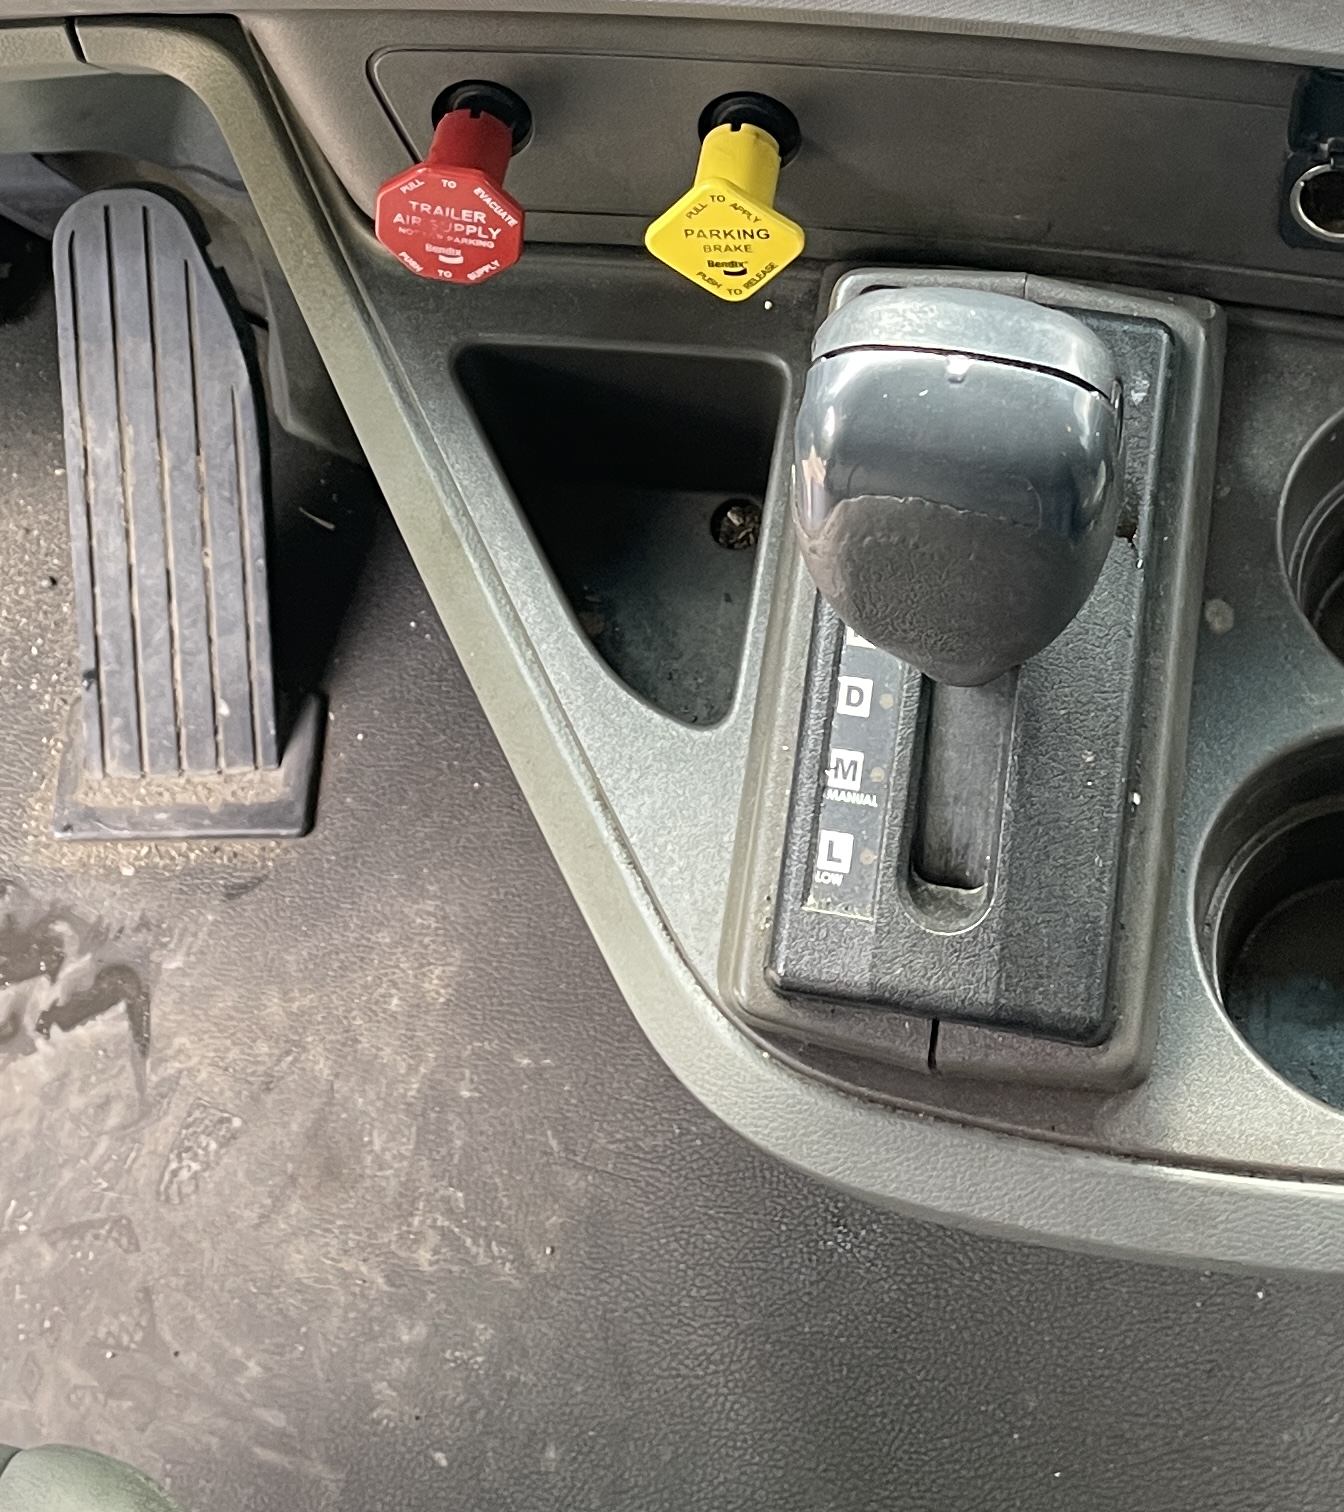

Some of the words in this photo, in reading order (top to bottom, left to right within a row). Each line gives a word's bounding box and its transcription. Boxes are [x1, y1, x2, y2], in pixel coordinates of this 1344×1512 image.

[400, 179, 425, 194] PULL
[441, 178, 457, 189] TO
[473, 187, 518, 228] EVACUATE
[408, 200, 487, 225] TRAILER
[685, 203, 709, 220] PULL
[709, 194, 726, 203] TO
[729, 202, 762, 224] APPLY
[392, 212, 422, 226] AIR
[684, 228, 771, 240] PARKING
[703, 244, 754, 254] BRAKE
[399, 251, 424, 273] PUSH
[437, 269, 453, 278] TO
[467, 259, 501, 281] SUPPLY
[696, 271, 723, 289] PUSH
[726, 288, 743, 296] TO
[743, 261, 779, 290] RELEASE
[845, 684, 865, 708] D
[834, 757, 859, 783] M
[826, 789, 879, 808] MANUAL
[826, 840, 843, 864] L
[814, 871, 844, 887] LOW
